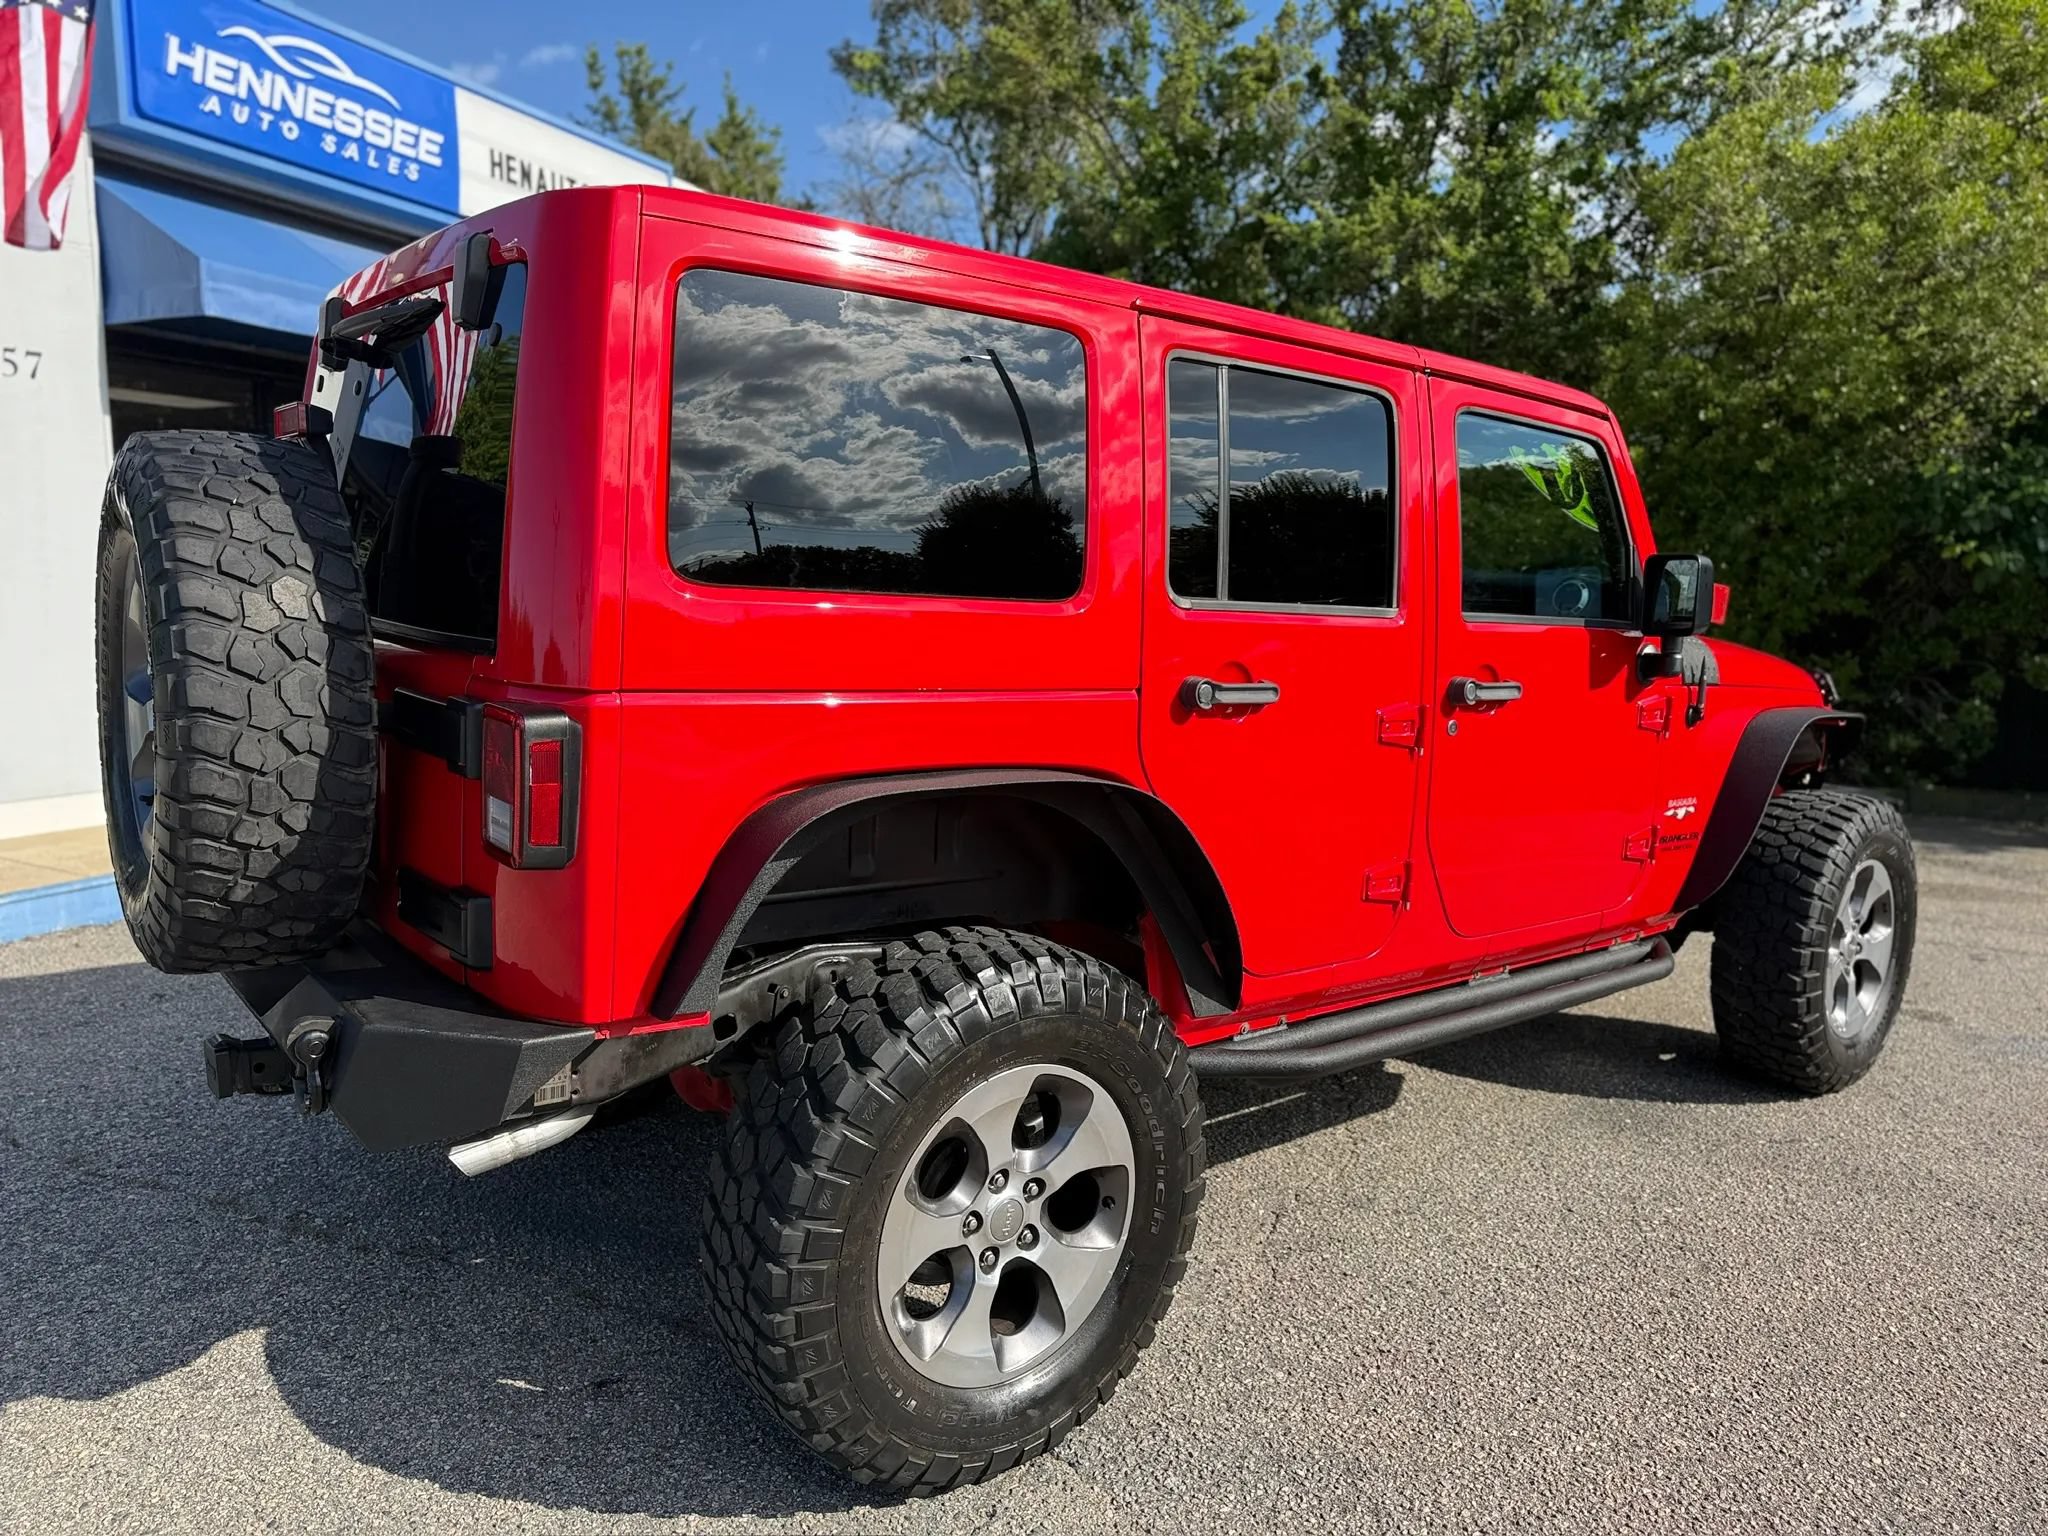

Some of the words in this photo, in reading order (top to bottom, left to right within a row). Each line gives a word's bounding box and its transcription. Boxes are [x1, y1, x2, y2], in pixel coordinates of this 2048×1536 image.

[164, 32, 445, 168] HENNESSEE
[200, 94, 300, 141] AUTO
[321, 132, 421, 182] SALES
[489, 147, 588, 194] HENAU
[2, 347, 43, 380] 57
